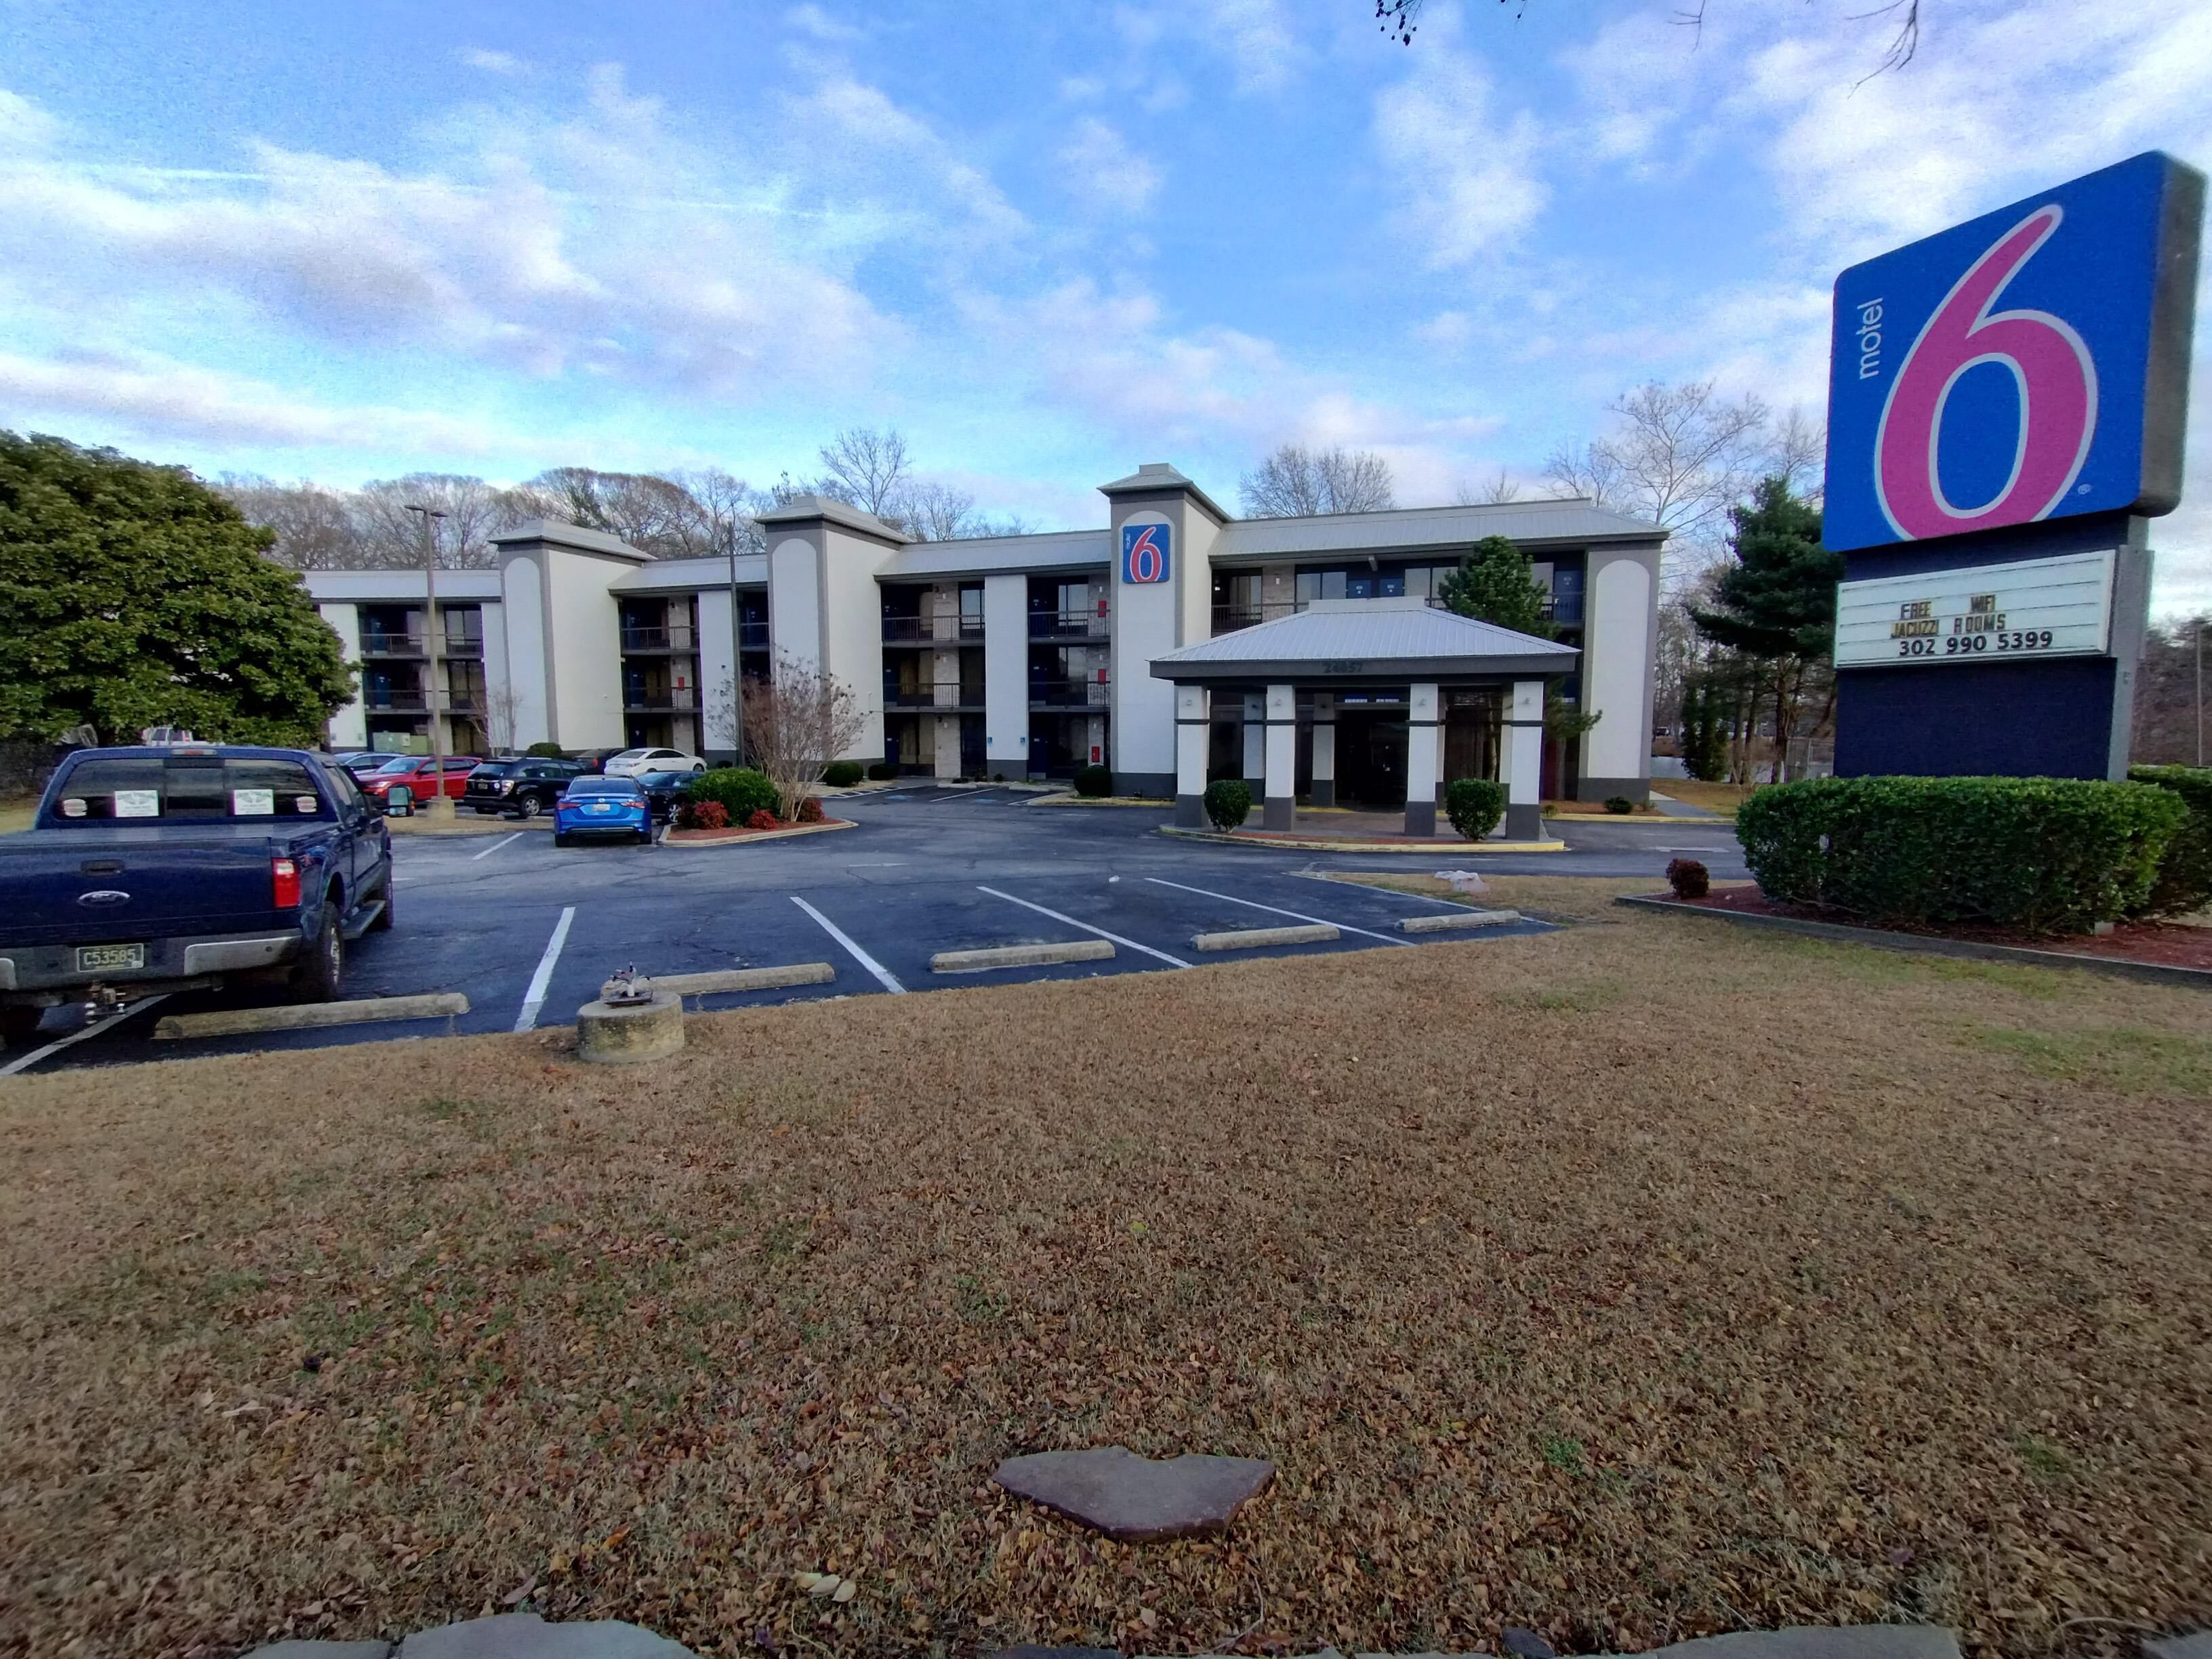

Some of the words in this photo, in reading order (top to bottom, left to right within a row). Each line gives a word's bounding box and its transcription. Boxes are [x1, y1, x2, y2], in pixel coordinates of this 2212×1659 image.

[1856, 298, 1883, 380] motel
[1874, 203, 2098, 541] 6
[1130, 526, 1162, 582] 6
[1900, 601, 1932, 619] FREE
[1971, 594, 1996, 613] WIFI
[1891, 619, 1940, 638] JACUZZI
[1953, 613, 2007, 634] ROOMS
[1899, 638, 1936, 656] 302
[1946, 635, 1987, 653] 990
[1997, 631, 2053, 650] 5399
[83, 949, 136, 965] C53585
